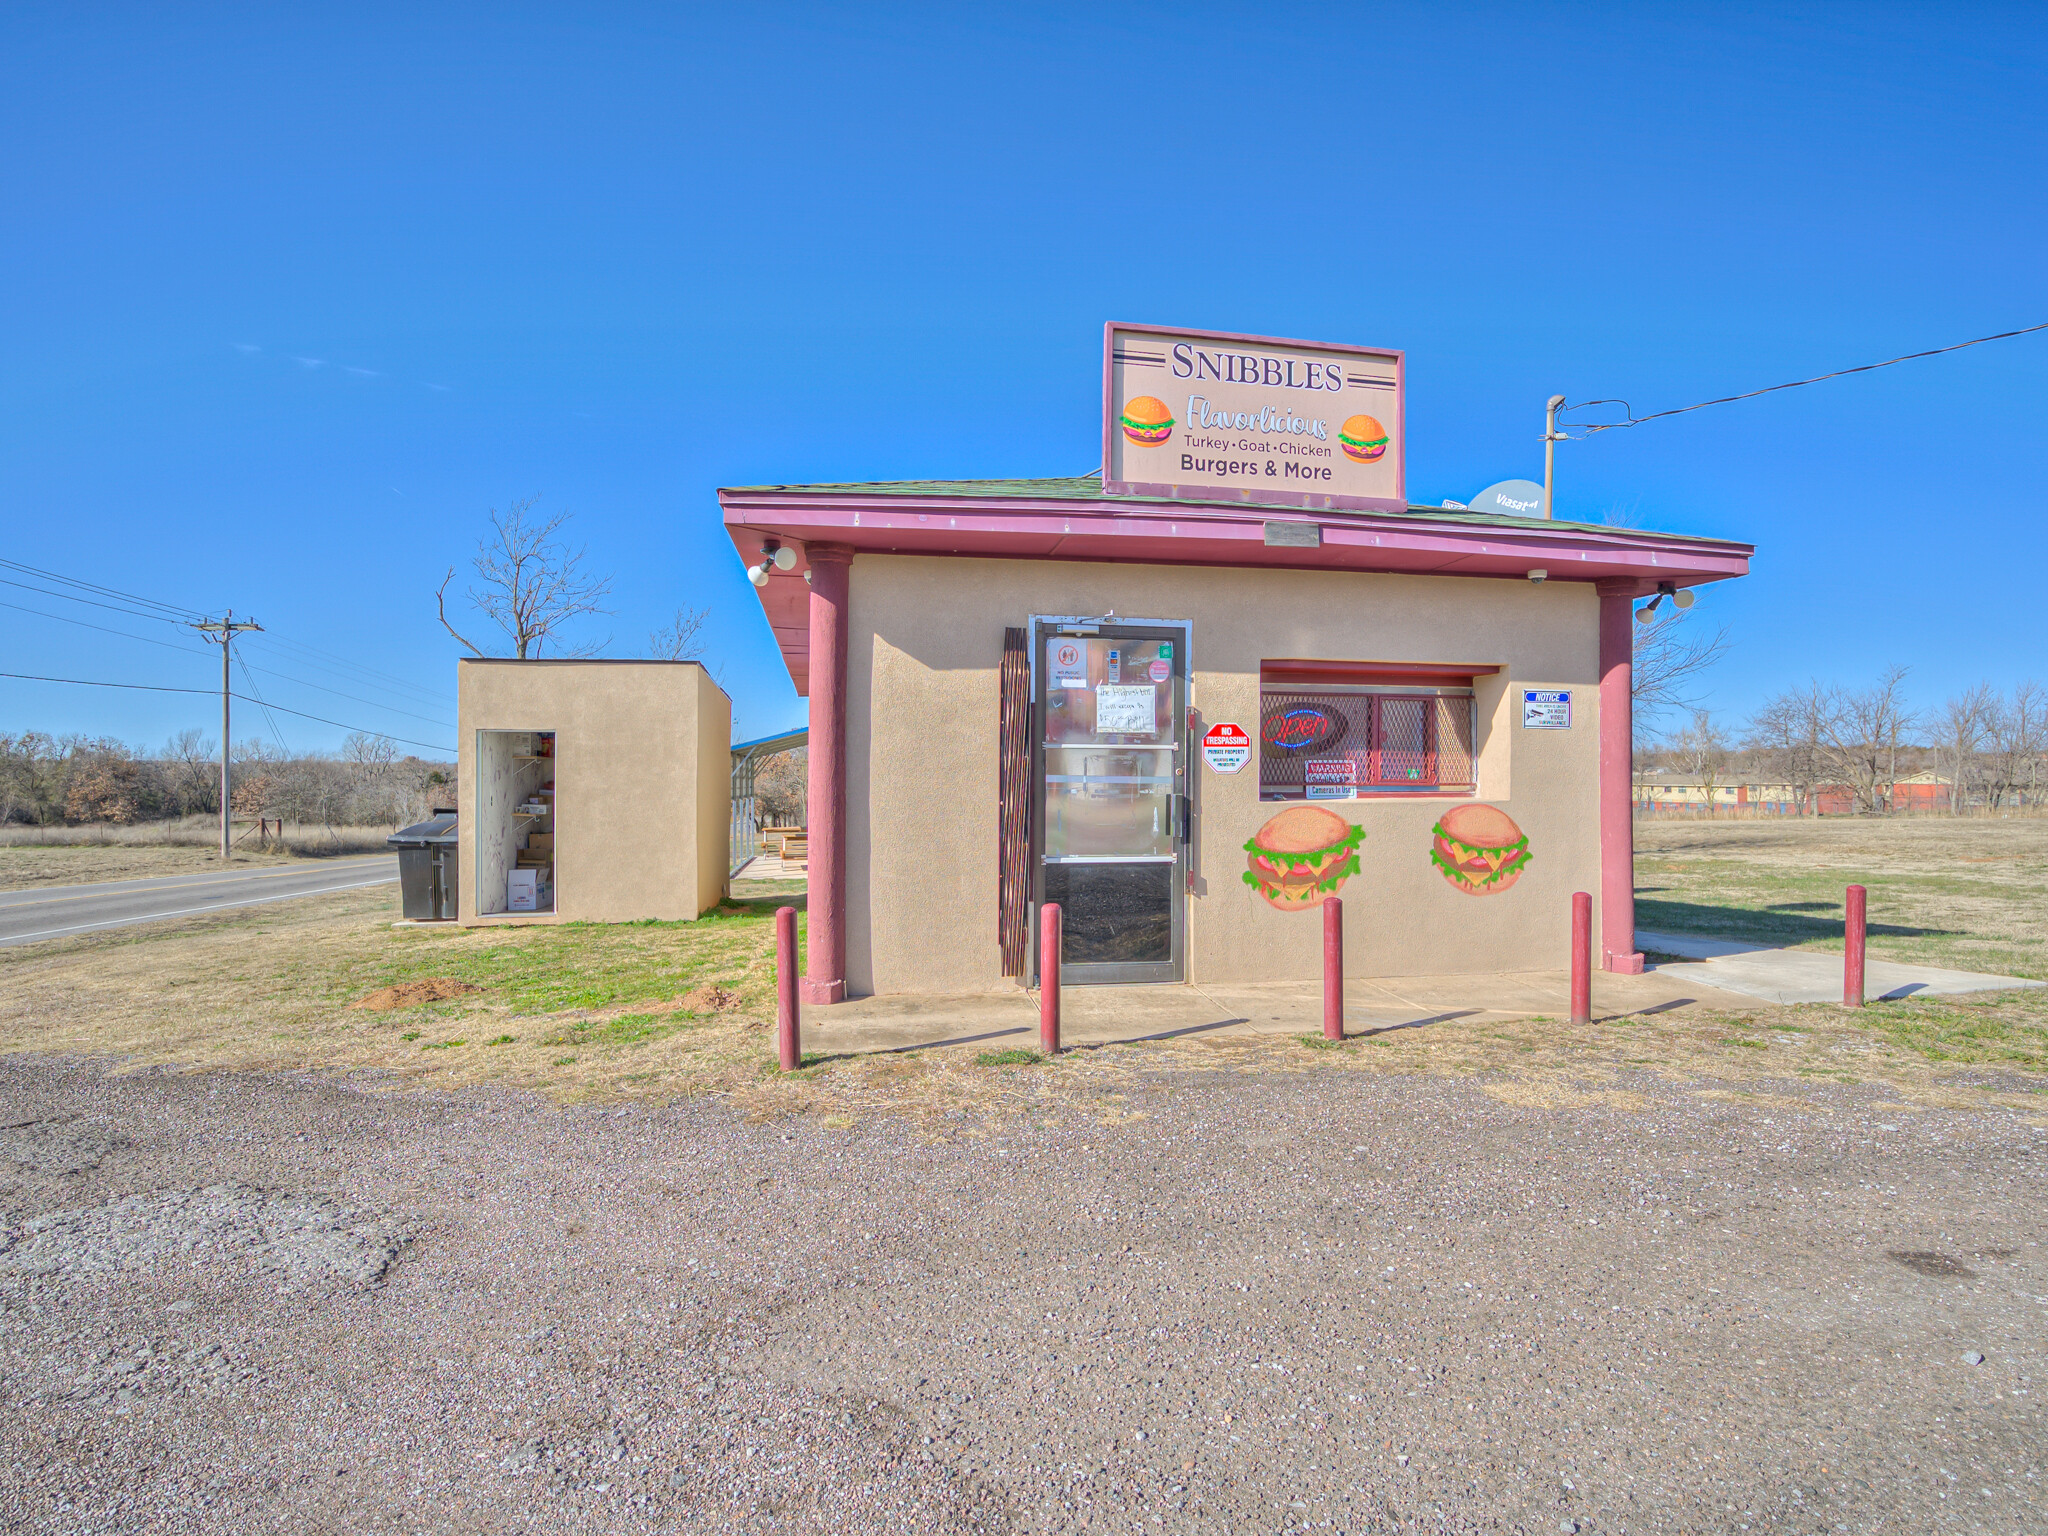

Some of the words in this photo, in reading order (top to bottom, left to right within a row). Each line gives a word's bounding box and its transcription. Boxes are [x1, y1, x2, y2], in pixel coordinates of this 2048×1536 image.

[1172, 343, 1343, 392] SNIBBLES
[1186, 394, 1328, 441] Flavorlicious
[1184, 435, 1230, 453] Turkey
[1238, 439, 1271, 453] Goat
[1279, 442, 1332, 458] Chicken
[1181, 454, 1258, 477] Burgers
[1264, 459, 1278, 477] &
[1284, 461, 1333, 480] More
[1496, 493, 1529, 512] Viasat
[1535, 693, 1561, 702] NOTICE
[1221, 727, 1233, 736] NO
[1262, 715, 1328, 743] Open
[1206, 736, 1248, 745] TRESPASSING
[1311, 764, 1351, 773] WARNING
[1312, 785, 1335, 794] Cameras
[1336, 785, 1341, 794] In
[1342, 785, 1351, 794] Use
